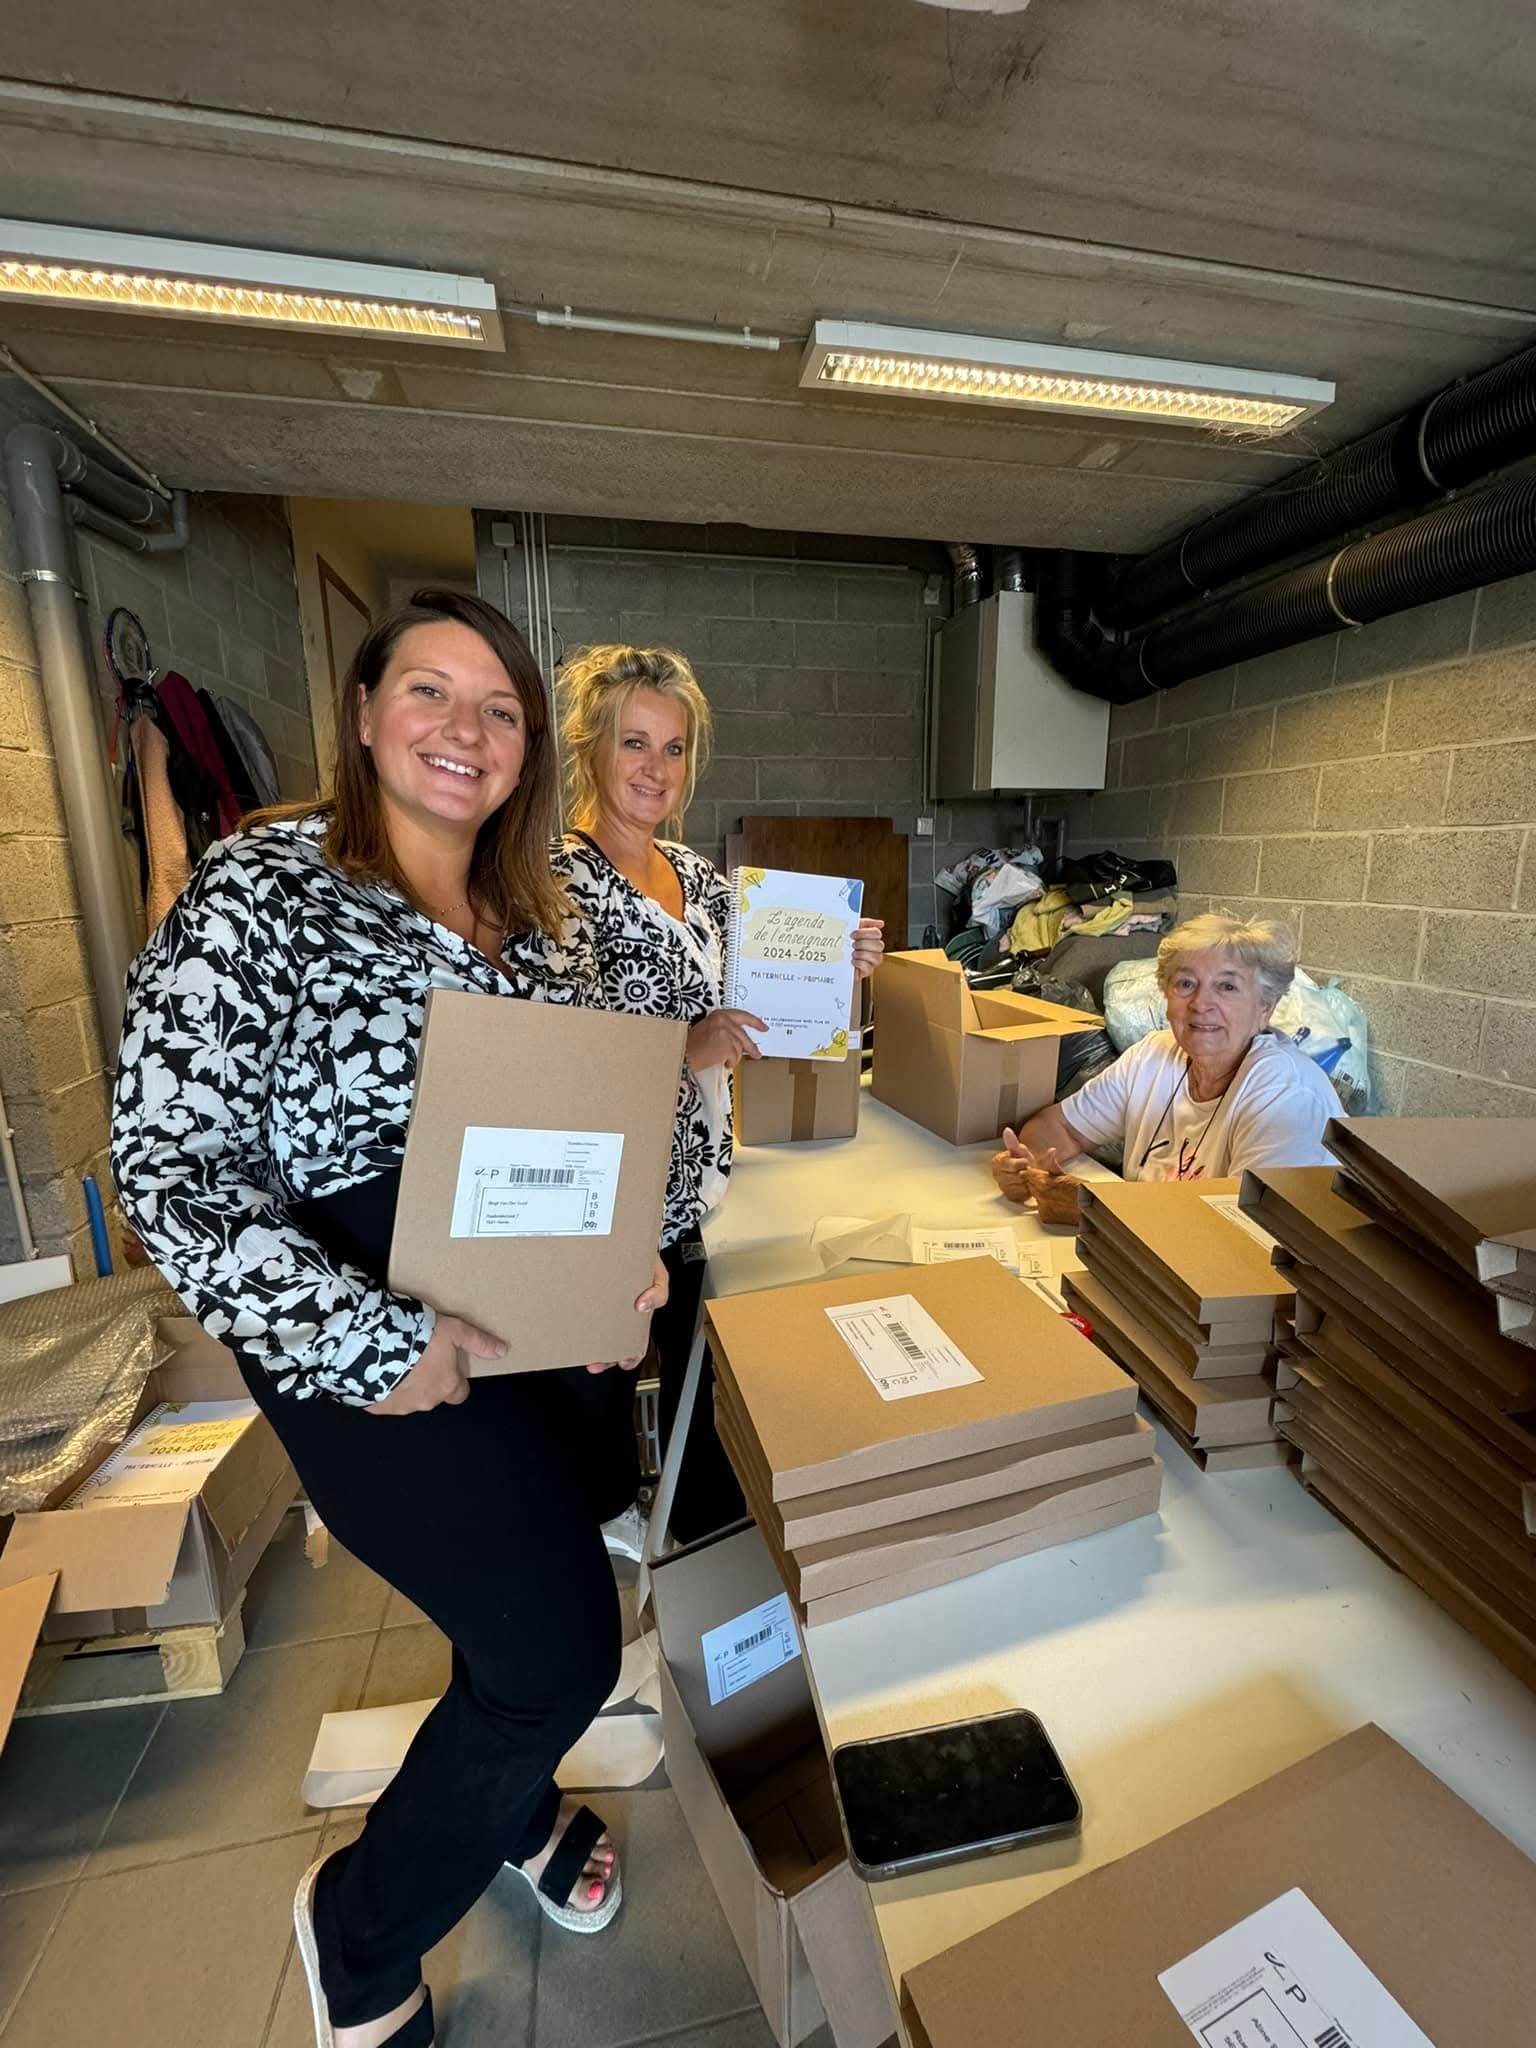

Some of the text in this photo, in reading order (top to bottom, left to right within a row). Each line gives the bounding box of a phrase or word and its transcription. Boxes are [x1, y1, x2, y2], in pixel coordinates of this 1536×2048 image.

[767, 910, 825, 932] L'agenda
[753, 925, 841, 950] de l'enseignant
[763, 946, 827, 962] 2024-2025
[751, 971, 795, 981] MATERNELLE
[490, 1169, 500, 1180] P
[589, 1201, 599, 1209] 15
[150, 1443, 217, 1455] 2024-2025
[1284, 1982, 1307, 2005] P
